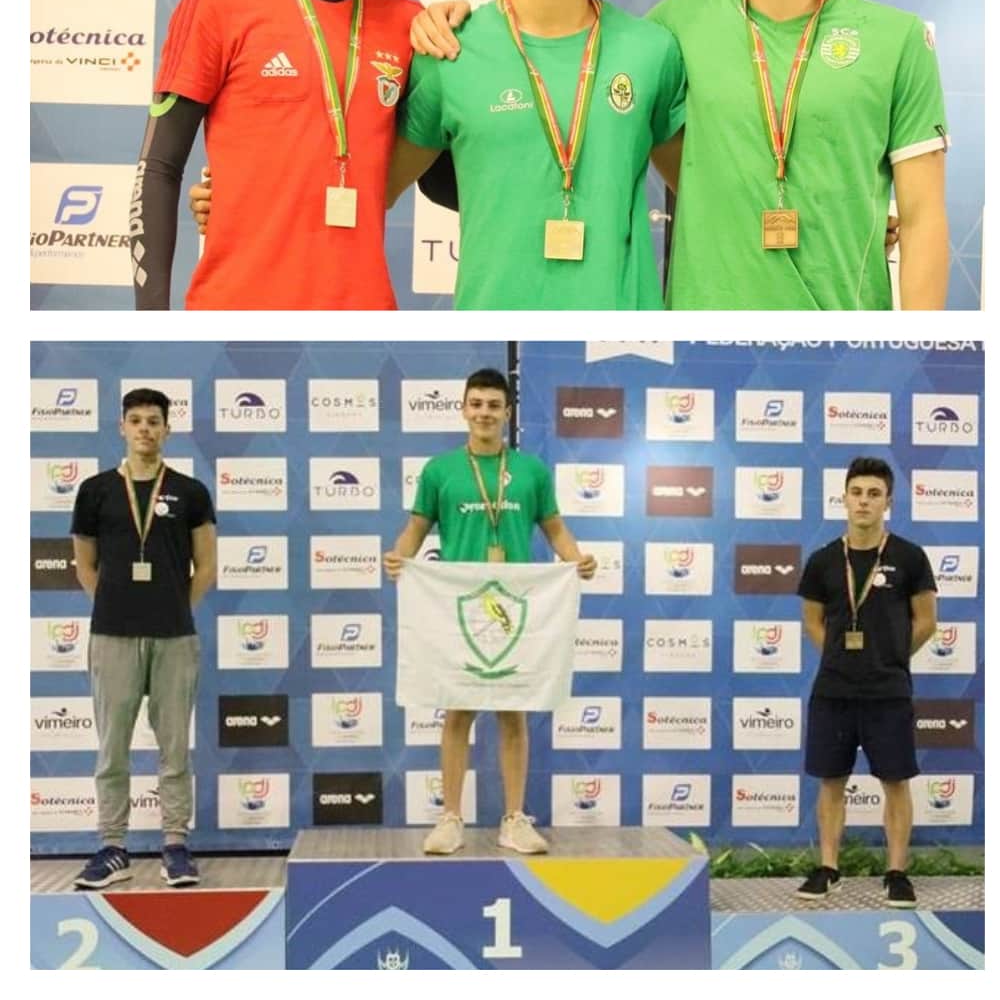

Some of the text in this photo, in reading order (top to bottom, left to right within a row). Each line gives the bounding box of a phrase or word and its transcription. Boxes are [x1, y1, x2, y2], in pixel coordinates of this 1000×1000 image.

[30, 28, 145, 47] otécnica
[66, 57, 115, 65] VINCI
[261, 68, 298, 77] adidas
[129, 160, 147, 236] arena
[220, 407, 280, 420] TURBO
[562, 408, 593, 417] arena
[827, 405, 887, 420] Sotécnica
[916, 422, 972, 434] TURBO
[220, 472, 283, 487] Sotécnica
[314, 486, 374, 498] TURBO
[652, 486, 683, 497] arena
[915, 484, 974, 498] Sotécnica
[315, 550, 377, 564] Sotécnica
[35, 559, 66, 570] arena
[741, 565, 771, 576] arena
[35, 717, 92, 730] vimeiro
[225, 717, 258, 727] arena
[647, 712, 707, 725] Sotécnica
[740, 716, 794, 730] vimeiro
[917, 719, 946, 729] arena
[31, 793, 95, 806] Sotécnica
[320, 794, 351, 805] arena
[736, 788, 796, 802] Sotécnica
[482, 898, 522, 958] 1
[56, 918, 99, 970] 2
[877, 921, 918, 970] 3
